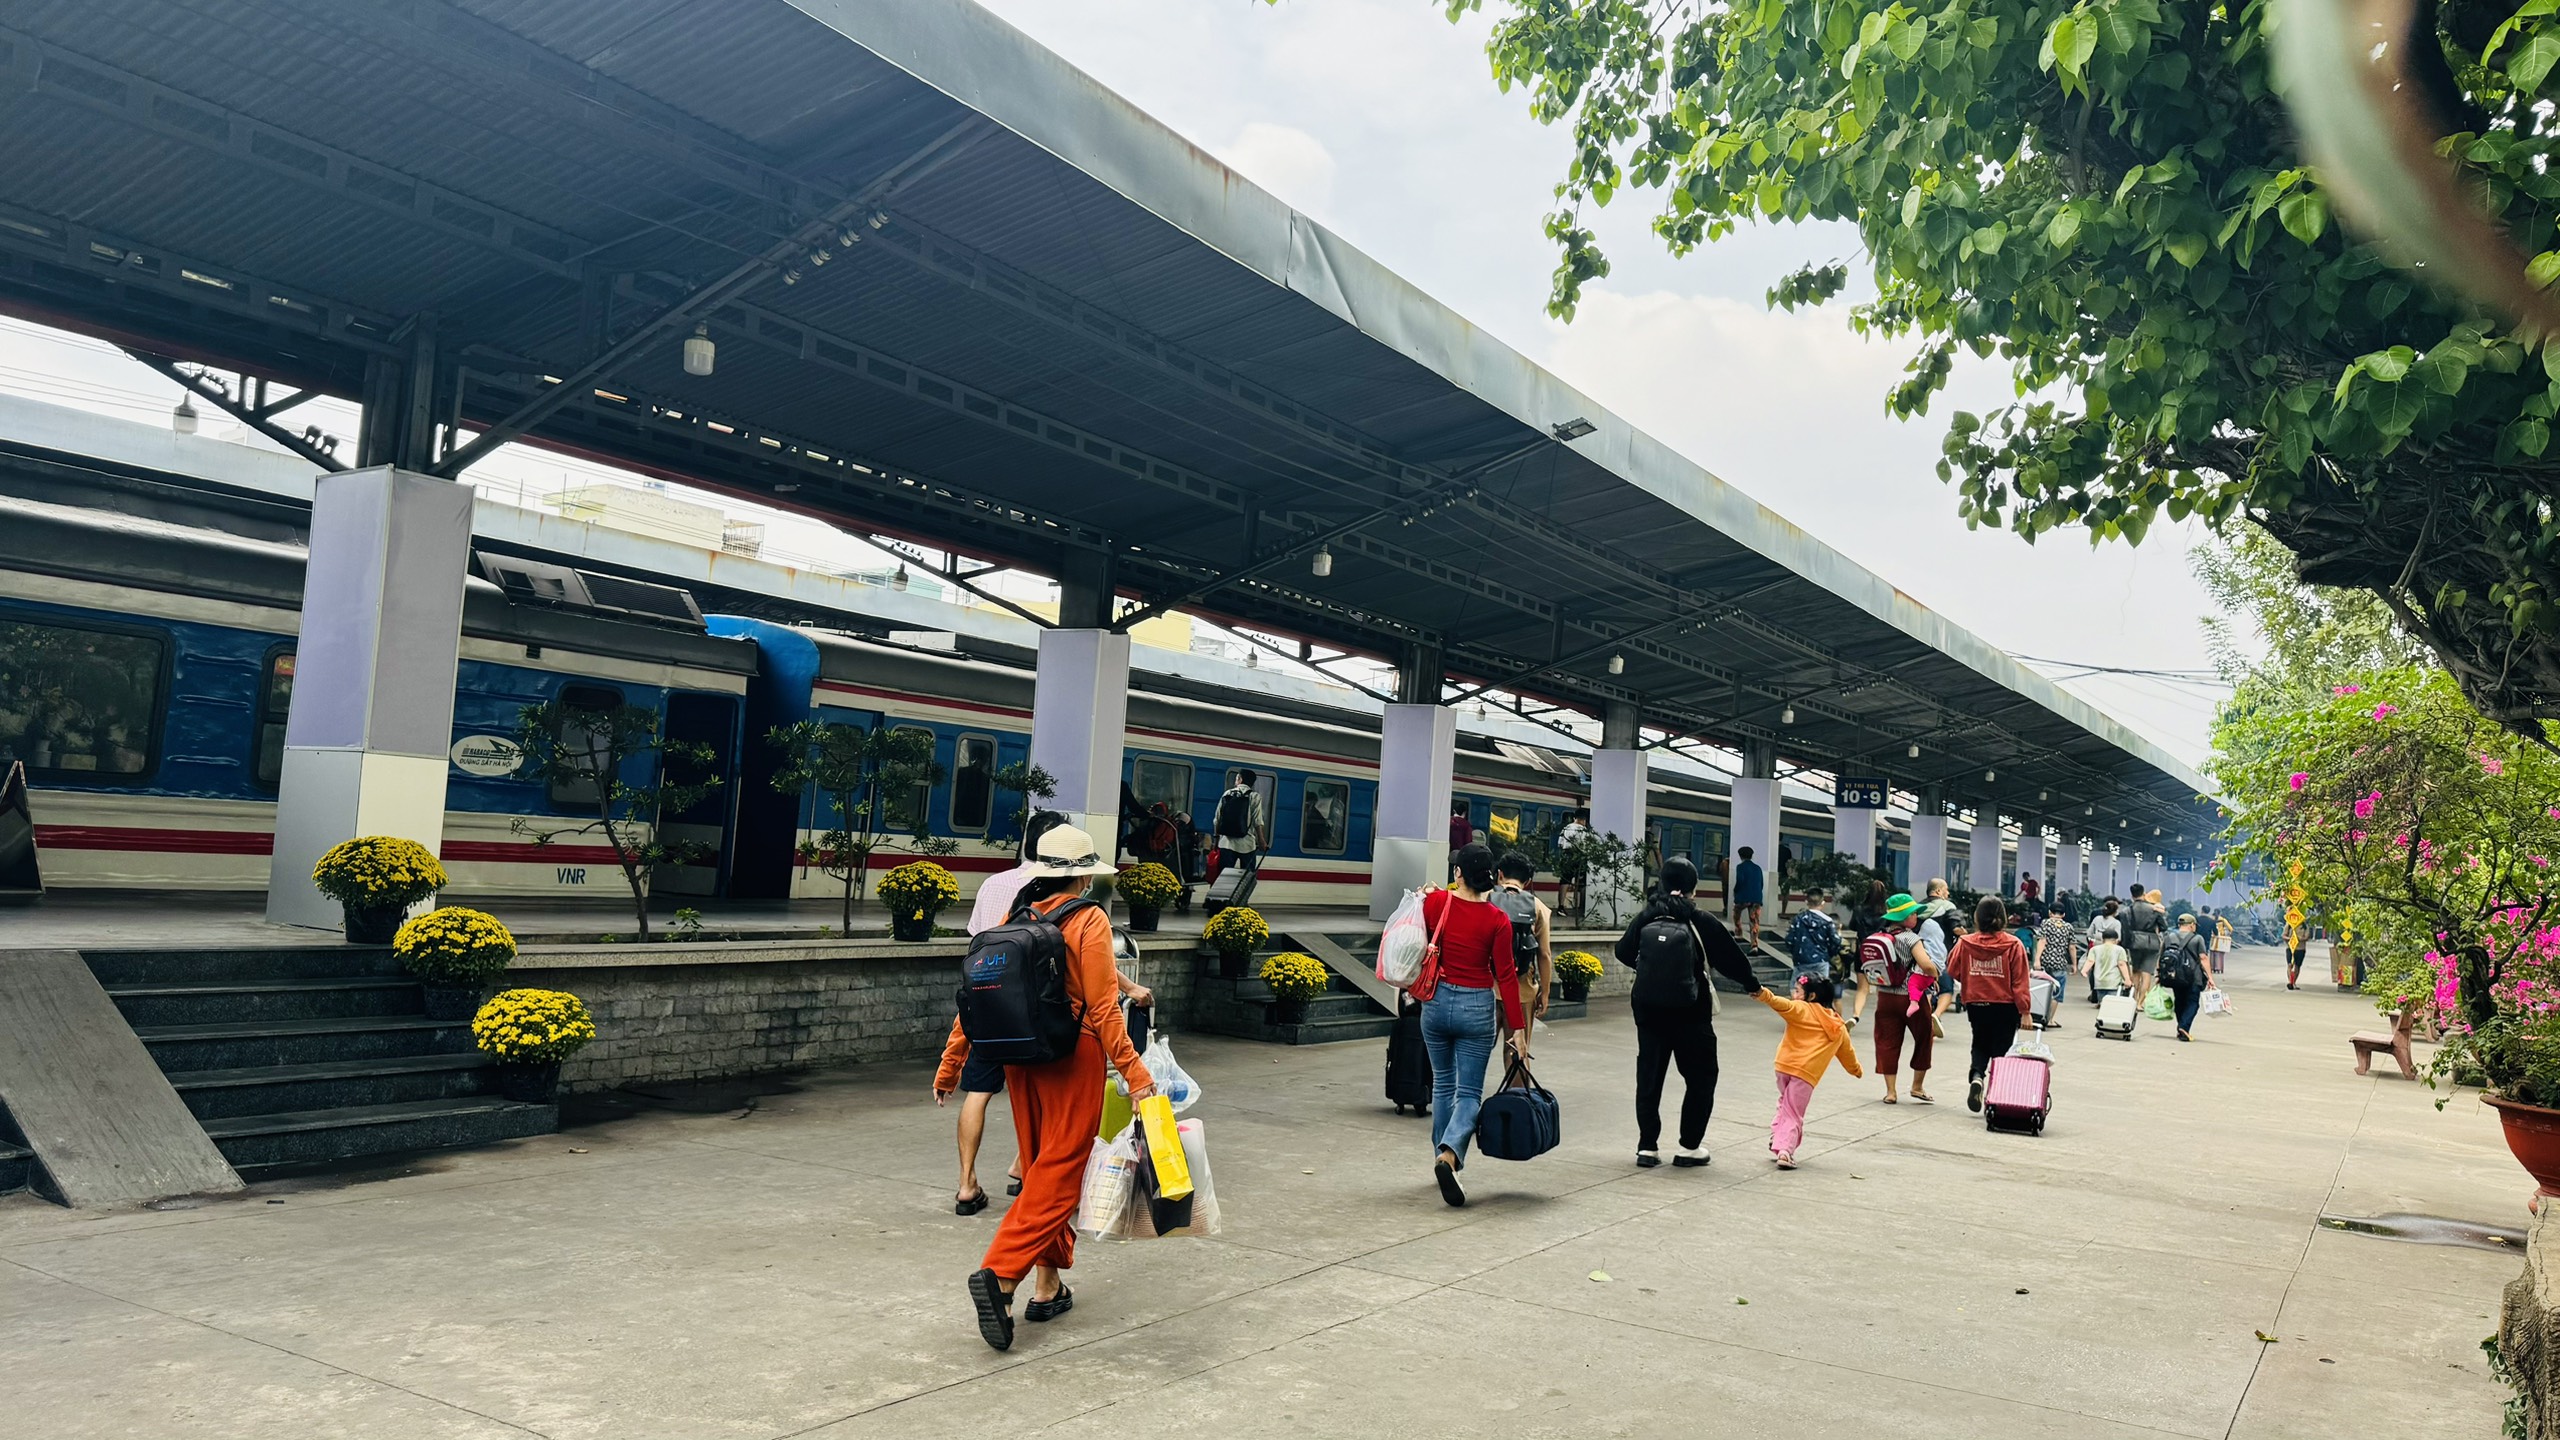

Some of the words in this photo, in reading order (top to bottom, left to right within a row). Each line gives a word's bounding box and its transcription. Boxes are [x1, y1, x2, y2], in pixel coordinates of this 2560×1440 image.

[1841, 789, 1861, 804] 10
[1869, 790, 1882, 805] 9
[2170, 862, 2177, 870] 8
[2182, 862, 2189, 870] 7
[557, 867, 586, 884] VNR
